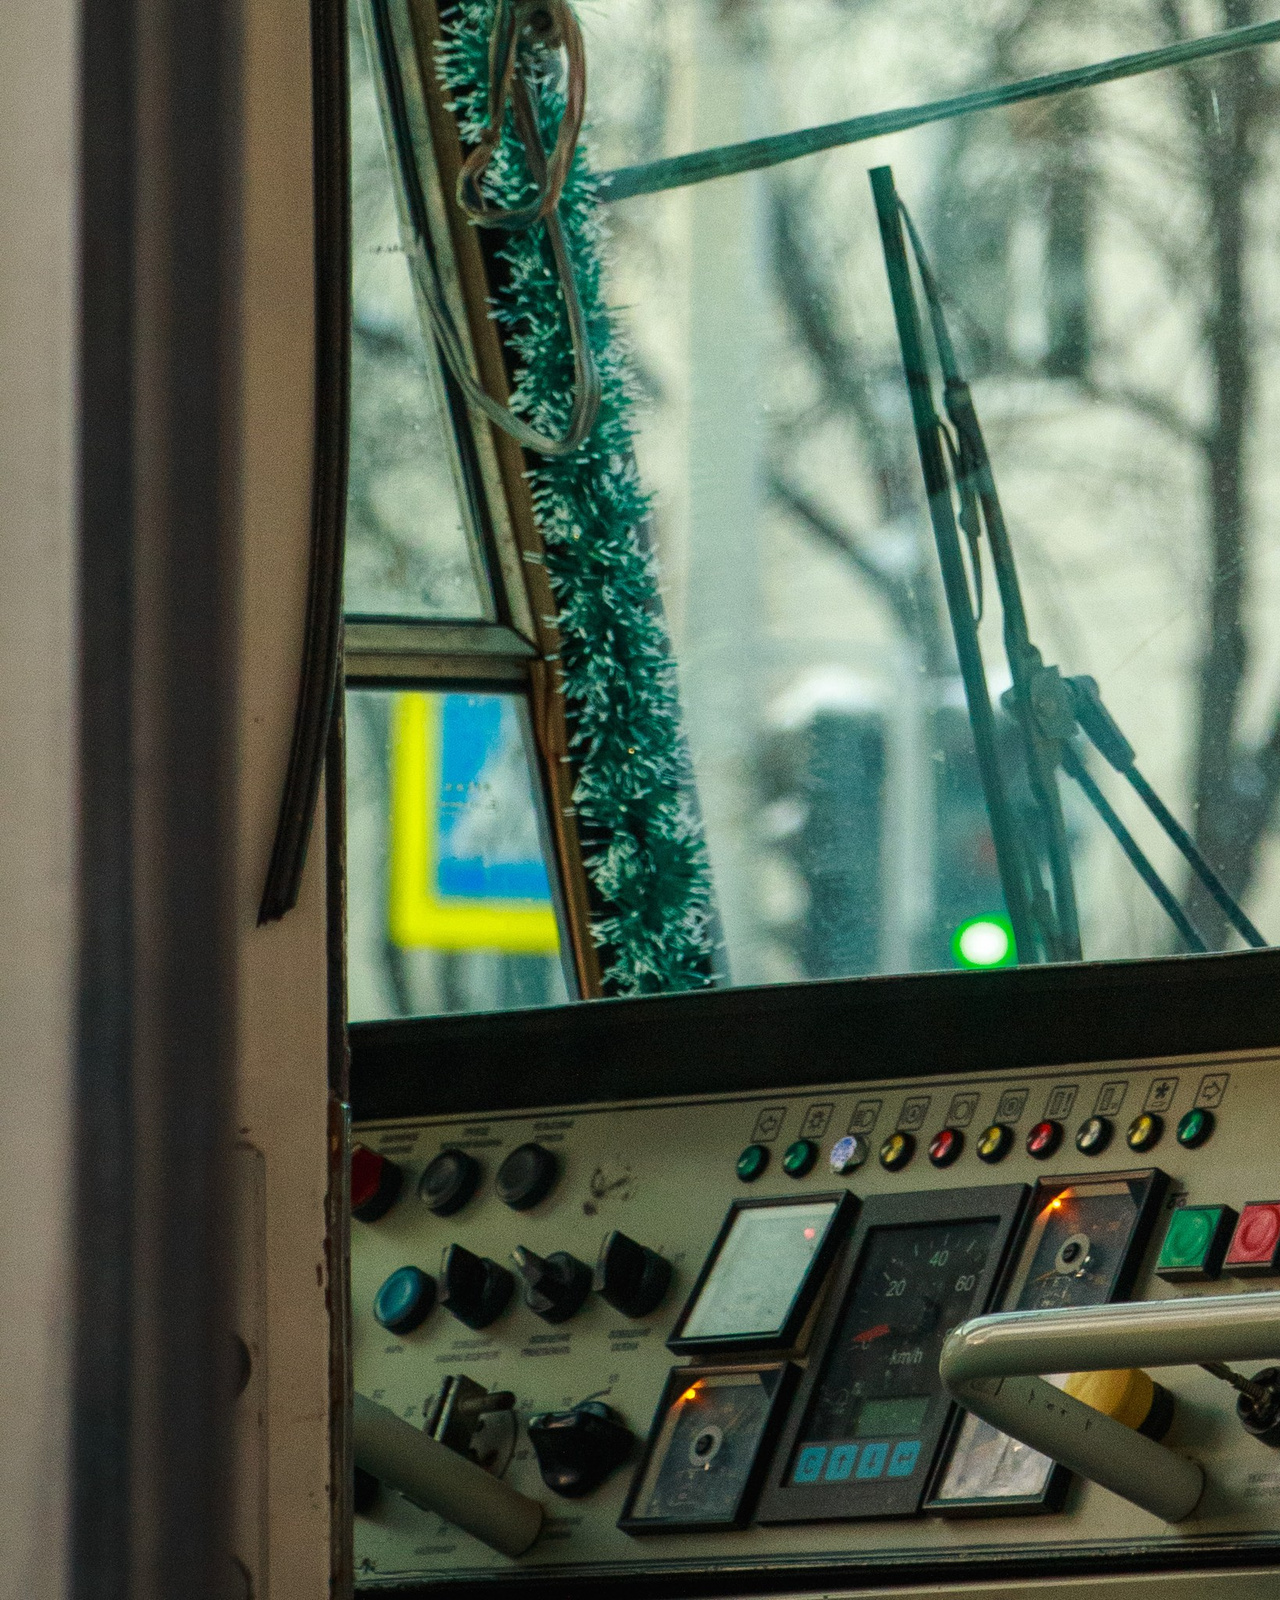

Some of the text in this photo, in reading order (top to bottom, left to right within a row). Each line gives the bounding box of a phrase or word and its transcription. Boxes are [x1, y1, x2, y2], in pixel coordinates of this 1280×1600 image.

[928, 1249, 950, 1268] 40
[885, 1274, 976, 1297] 20 60
[888, 1346, 924, 1365] km/h
